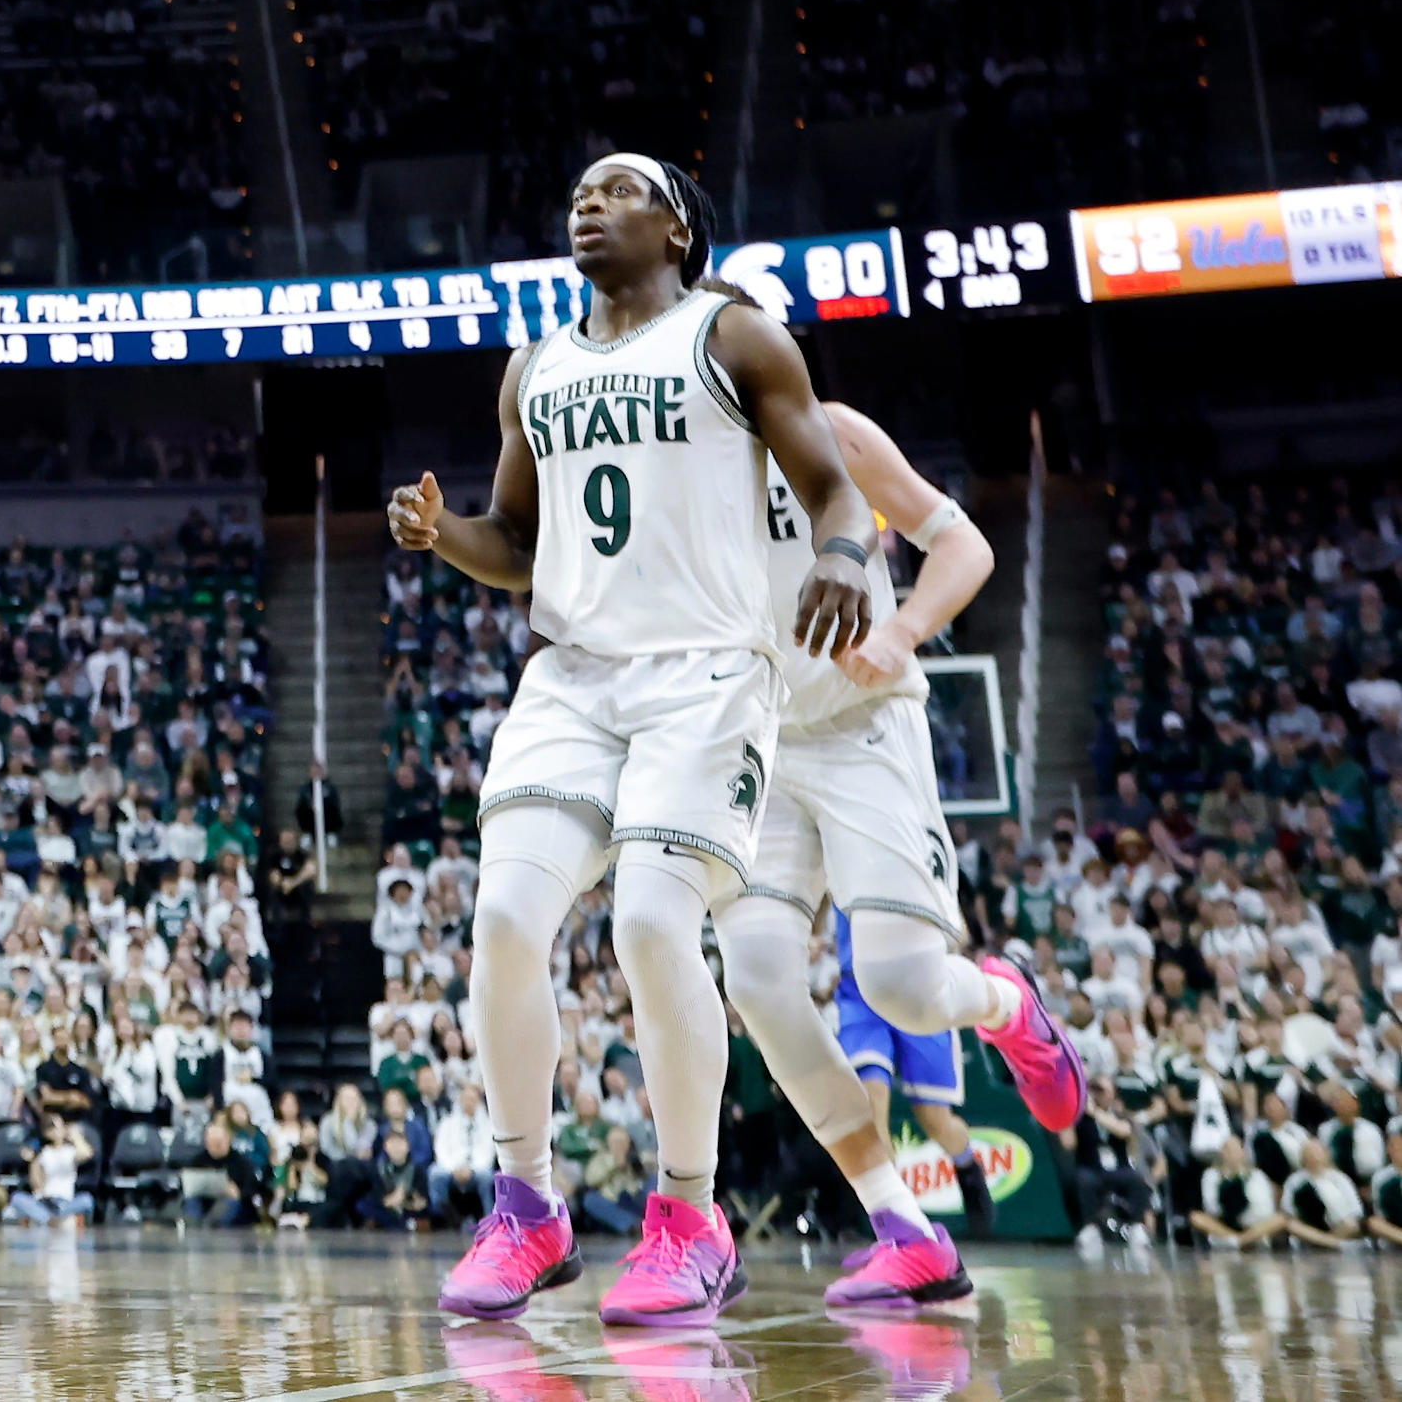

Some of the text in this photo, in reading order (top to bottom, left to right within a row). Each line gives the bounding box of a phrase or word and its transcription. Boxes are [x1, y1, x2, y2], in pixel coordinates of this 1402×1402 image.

[804, 241, 887, 301] 80
[923, 221, 1050, 278] 3:43
[1092, 215, 1182, 277] 52
[529, 377, 692, 459] STATE
[553, 374, 652, 407] MICHIGAN
[583, 464, 631, 556] 9
